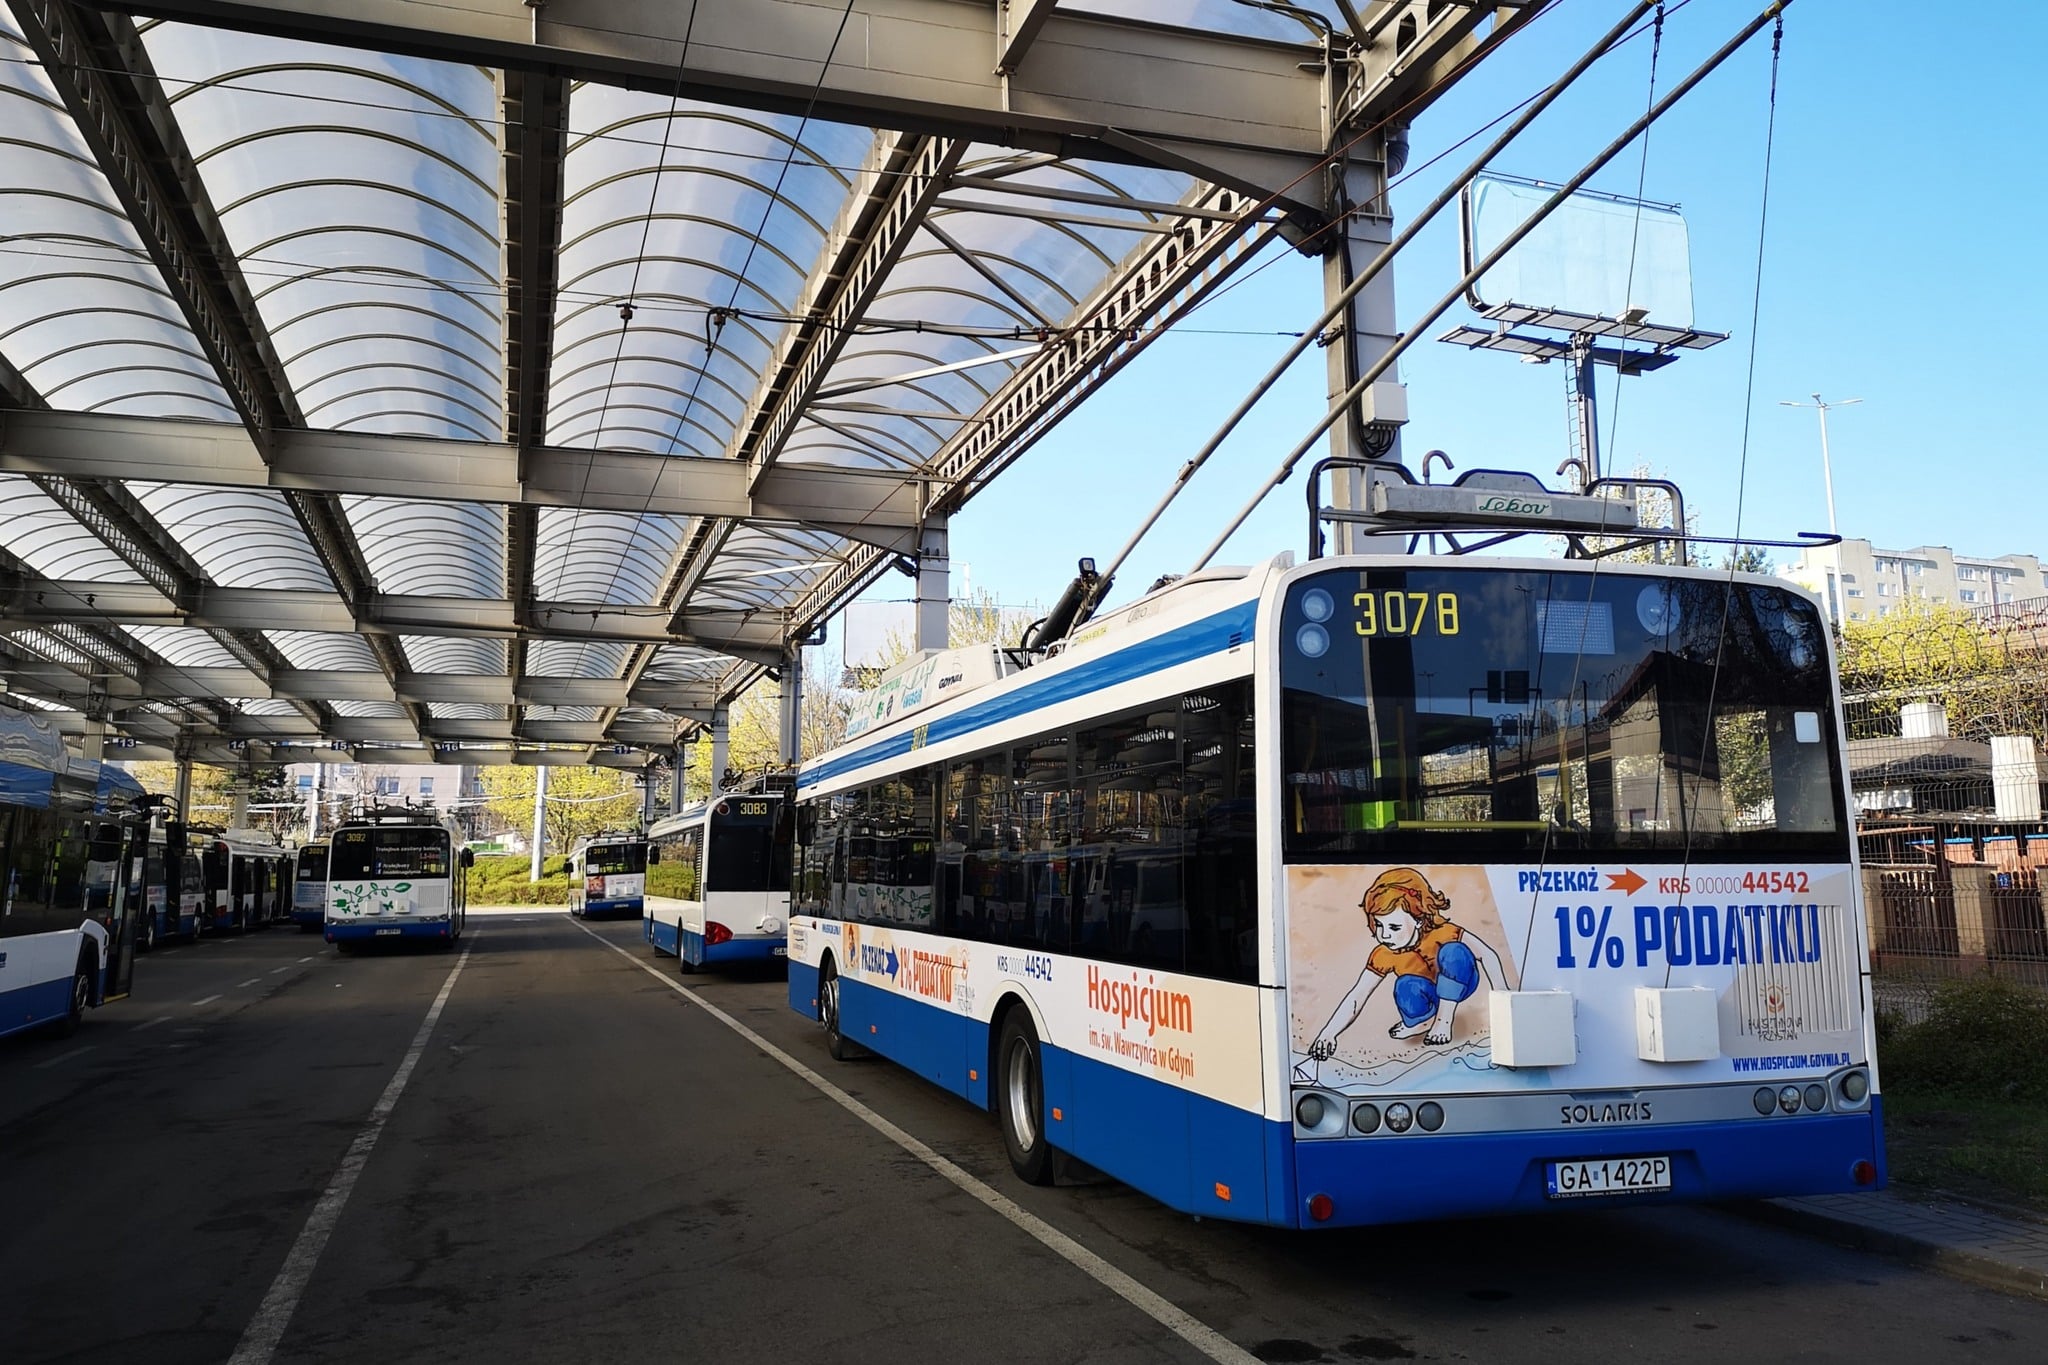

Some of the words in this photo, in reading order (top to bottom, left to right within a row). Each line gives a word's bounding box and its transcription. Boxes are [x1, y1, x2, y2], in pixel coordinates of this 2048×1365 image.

[1479, 497, 1549, 514] Lekov
[1353, 591, 1459, 635] 3078
[119, 739, 135, 747] 13
[231, 741, 246, 749] 14
[333, 742, 348, 750] 15
[740, 802, 767, 815] 3083
[1518, 867, 1599, 892] PRZEKAŻ
[1659, 877, 1691, 894] KRS
[1696, 871, 1810, 894] 0000044542
[1553, 905, 1625, 969] 1%
[1634, 904, 1821, 968] PODATKU
[900, 947, 912, 991] 1%
[913, 950, 952, 1003] PODATKU
[997, 955, 1008, 973] KRS
[1087, 965, 1193, 1037] Hospicjum
[1089, 1025, 1100, 1047] im.
[1101, 1028, 1113, 1052] św.
[1114, 1032, 1157, 1066] Wawrzyńca
[1159, 1051, 1166, 1069] w
[1168, 1047, 1194, 1080] Gdyni
[1732, 1052, 1852, 1072] WWW.HOSPICJUM.GDYNIA.PL
[1561, 1102, 1652, 1124] SOLARIS
[1560, 1164, 1592, 1190] GA
[1602, 1159, 1666, 1187] 1422P
